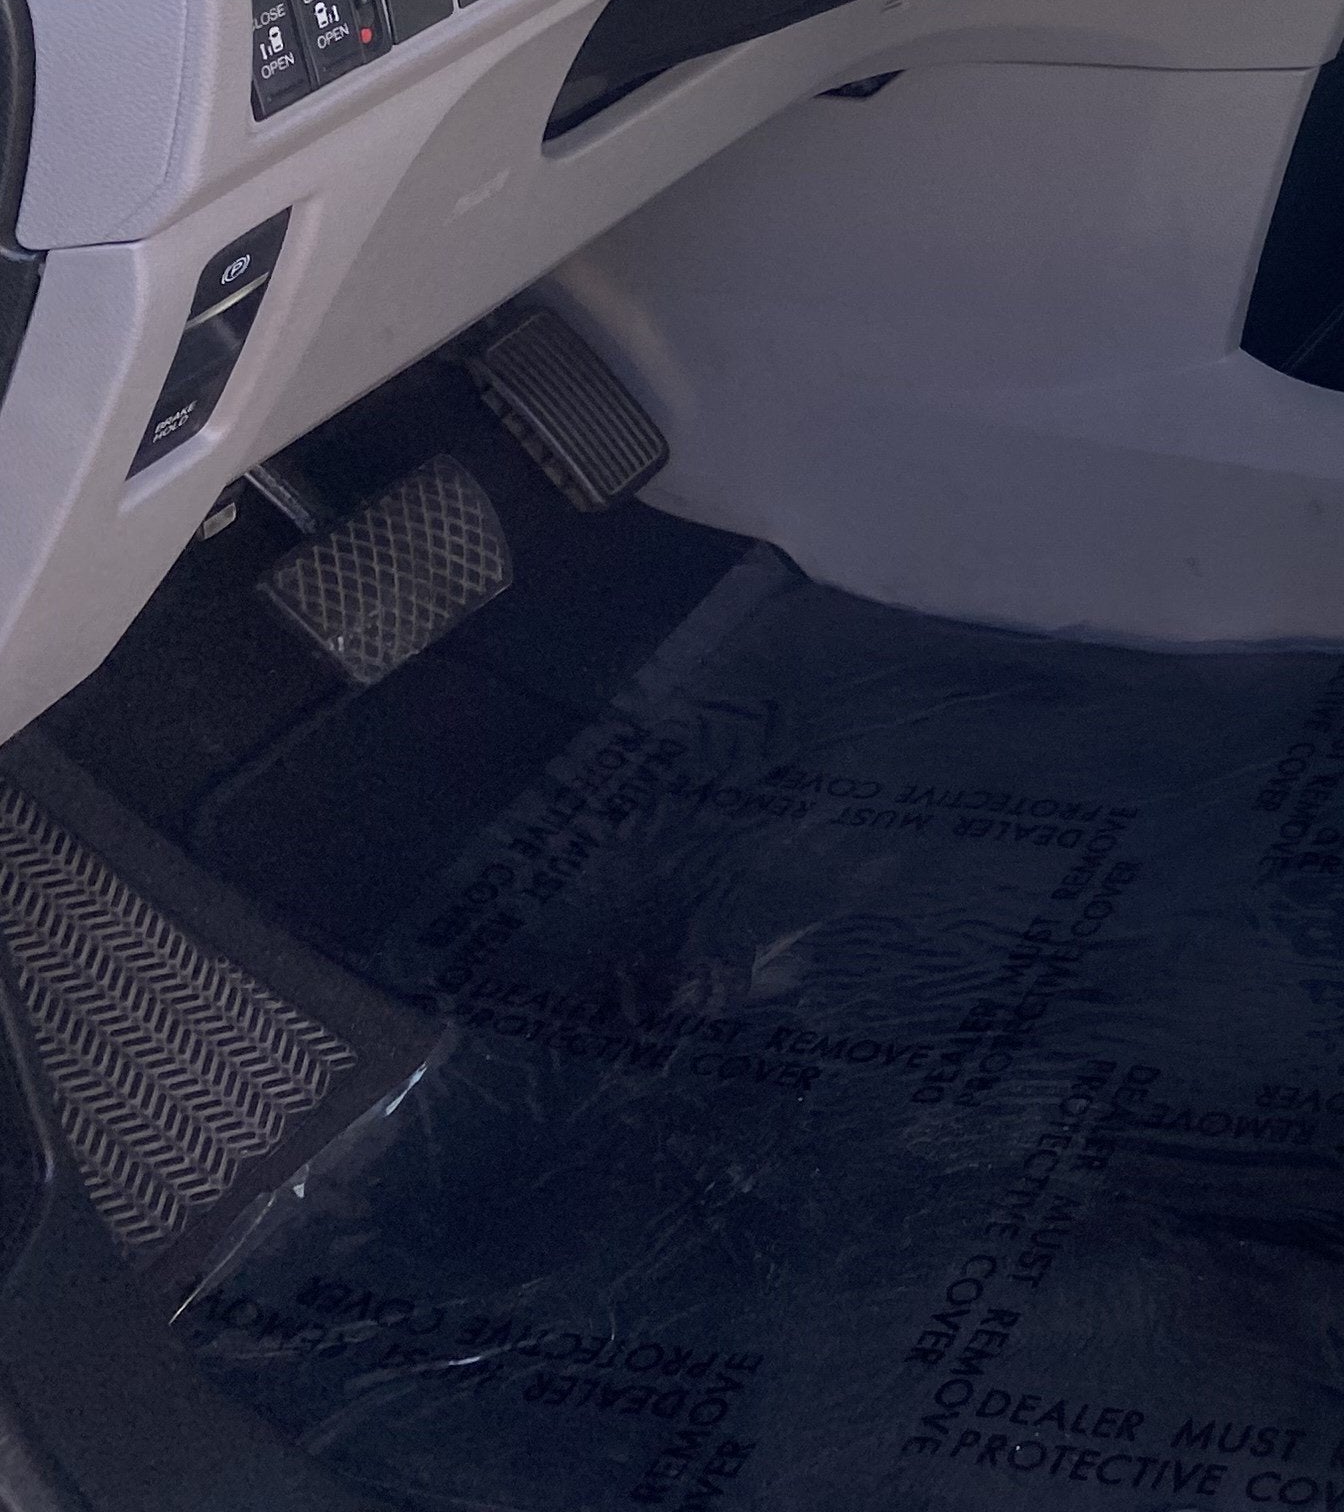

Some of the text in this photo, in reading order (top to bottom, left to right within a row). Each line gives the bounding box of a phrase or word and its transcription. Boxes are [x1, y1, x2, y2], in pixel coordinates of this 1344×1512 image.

[261, 52, 296, 79] OPEN
[317, 23, 350, 50] OPEN
[903, 1253, 999, 1368] COVER
[900, 1306, 1022, 1457] REMOVE
[975, 1387, 1146, 1442] DEALER
[1170, 1416, 1307, 1462] MUST
[948, 1428, 1230, 1497] PROTECTIVE
